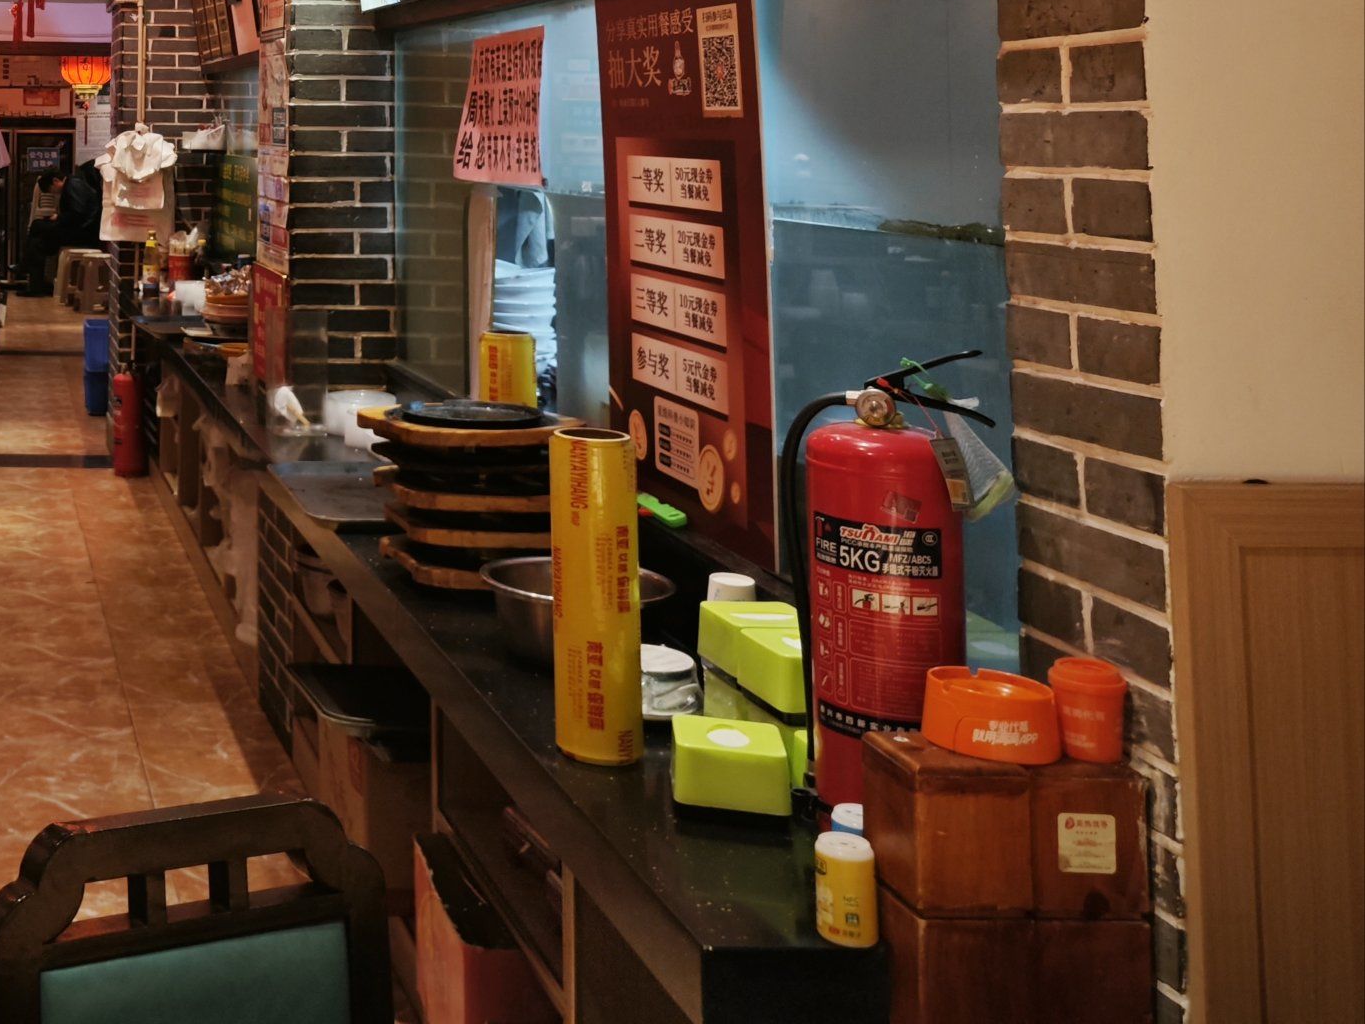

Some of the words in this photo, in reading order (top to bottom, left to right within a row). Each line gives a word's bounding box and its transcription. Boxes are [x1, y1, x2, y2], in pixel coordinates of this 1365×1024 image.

[604, 7, 695, 44] 分享真实用餐感受
[607, 45, 664, 90] 抽大奖
[631, 166, 665, 194] 一等奖
[674, 166, 714, 185] 50元现金券
[679, 183, 711, 202] 当餐减免
[633, 225, 668, 255] 二等奖
[676, 229, 716, 251] 20元现金券
[681, 247, 713, 268] 当餐减免
[635, 287, 669, 318] 三等奖
[679, 293, 718, 317] 10元现金券
[684, 312, 715, 334] 当餐减免
[636, 345, 671, 381] 参与奖
[682, 360, 718, 384] 5元代金券
[685, 376, 717, 401] 当餐减免
[815, 536, 838, 553] FIRE
[839, 544, 882, 575] 5KG
[881, 562, 939, 577] 手提式干粉灭火器
[889, 552, 933, 565] MFZ/ABC5
